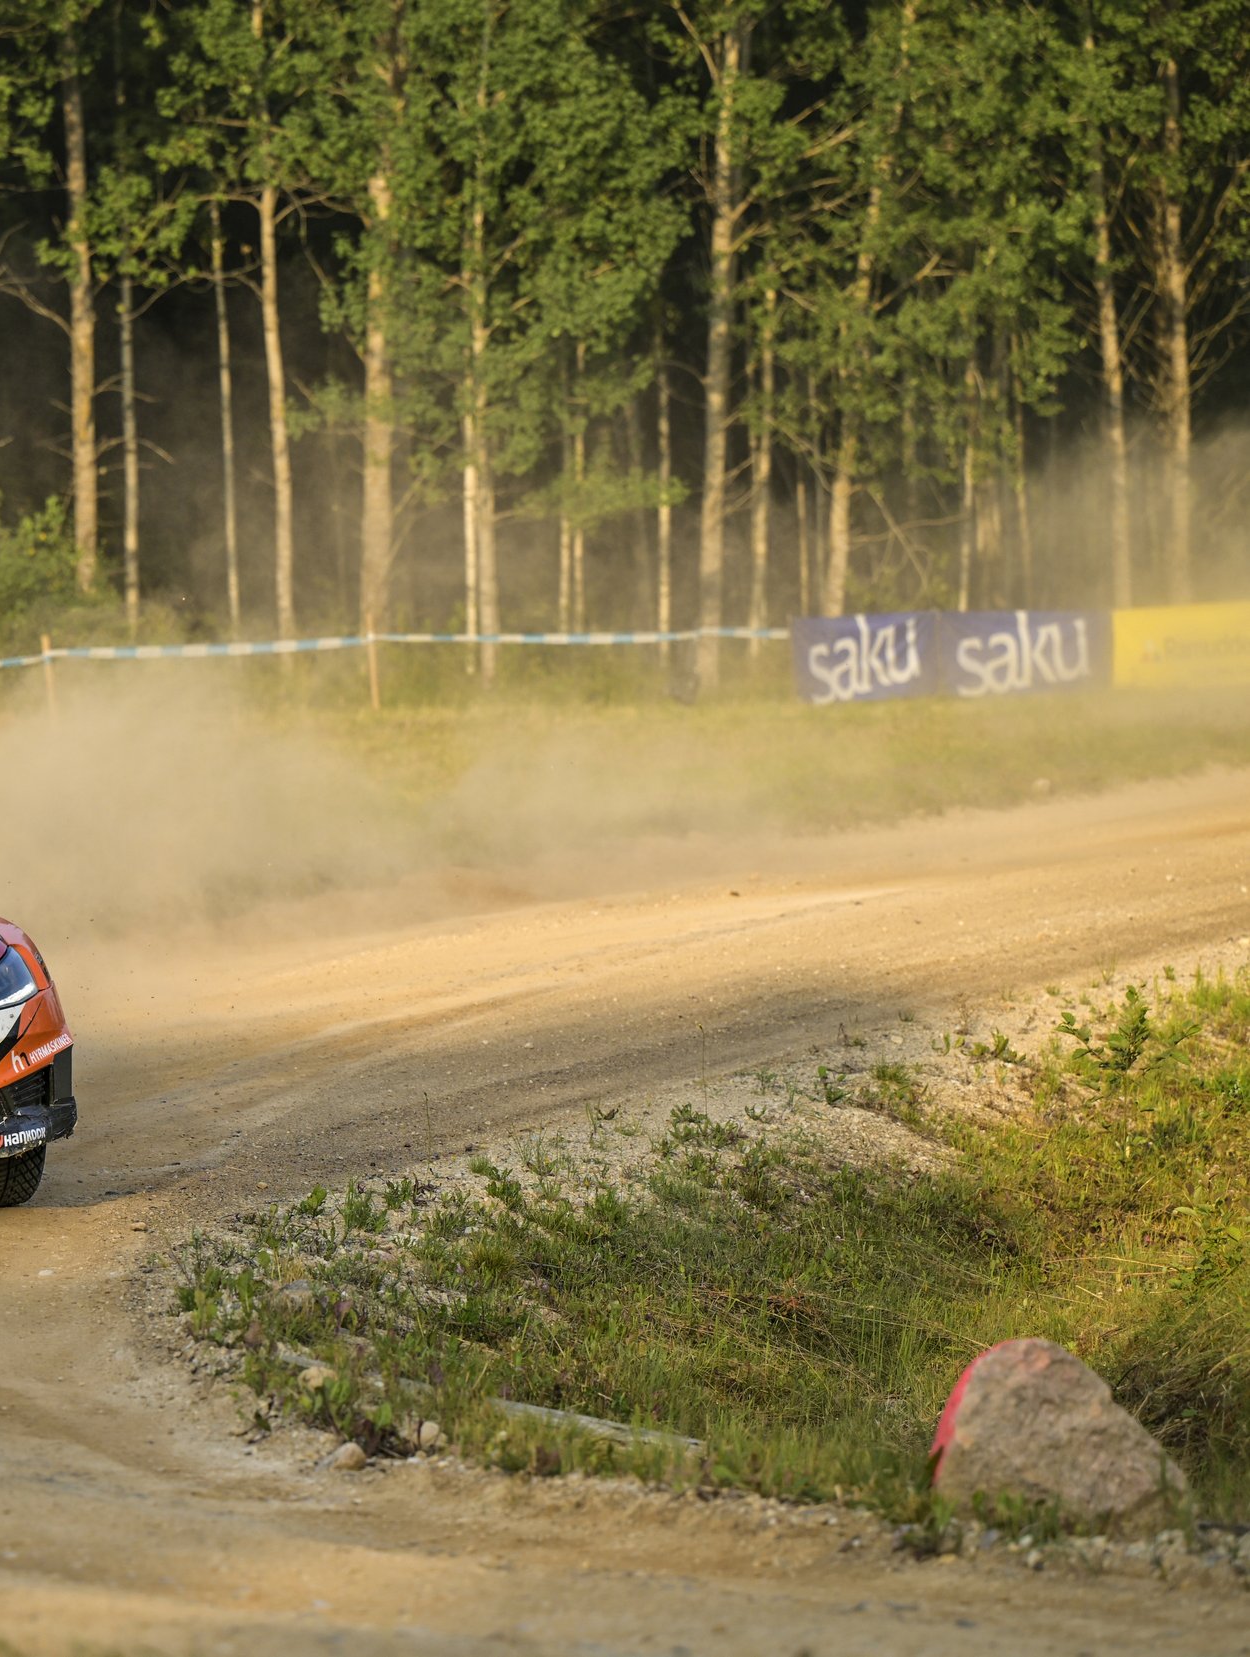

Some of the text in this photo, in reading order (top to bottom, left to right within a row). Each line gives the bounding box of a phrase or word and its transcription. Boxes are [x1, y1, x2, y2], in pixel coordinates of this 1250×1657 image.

[808, 613, 921, 706] saku
[956, 610, 1090, 697] saku
[29, 1033, 73, 1064] HYRMASKINER
